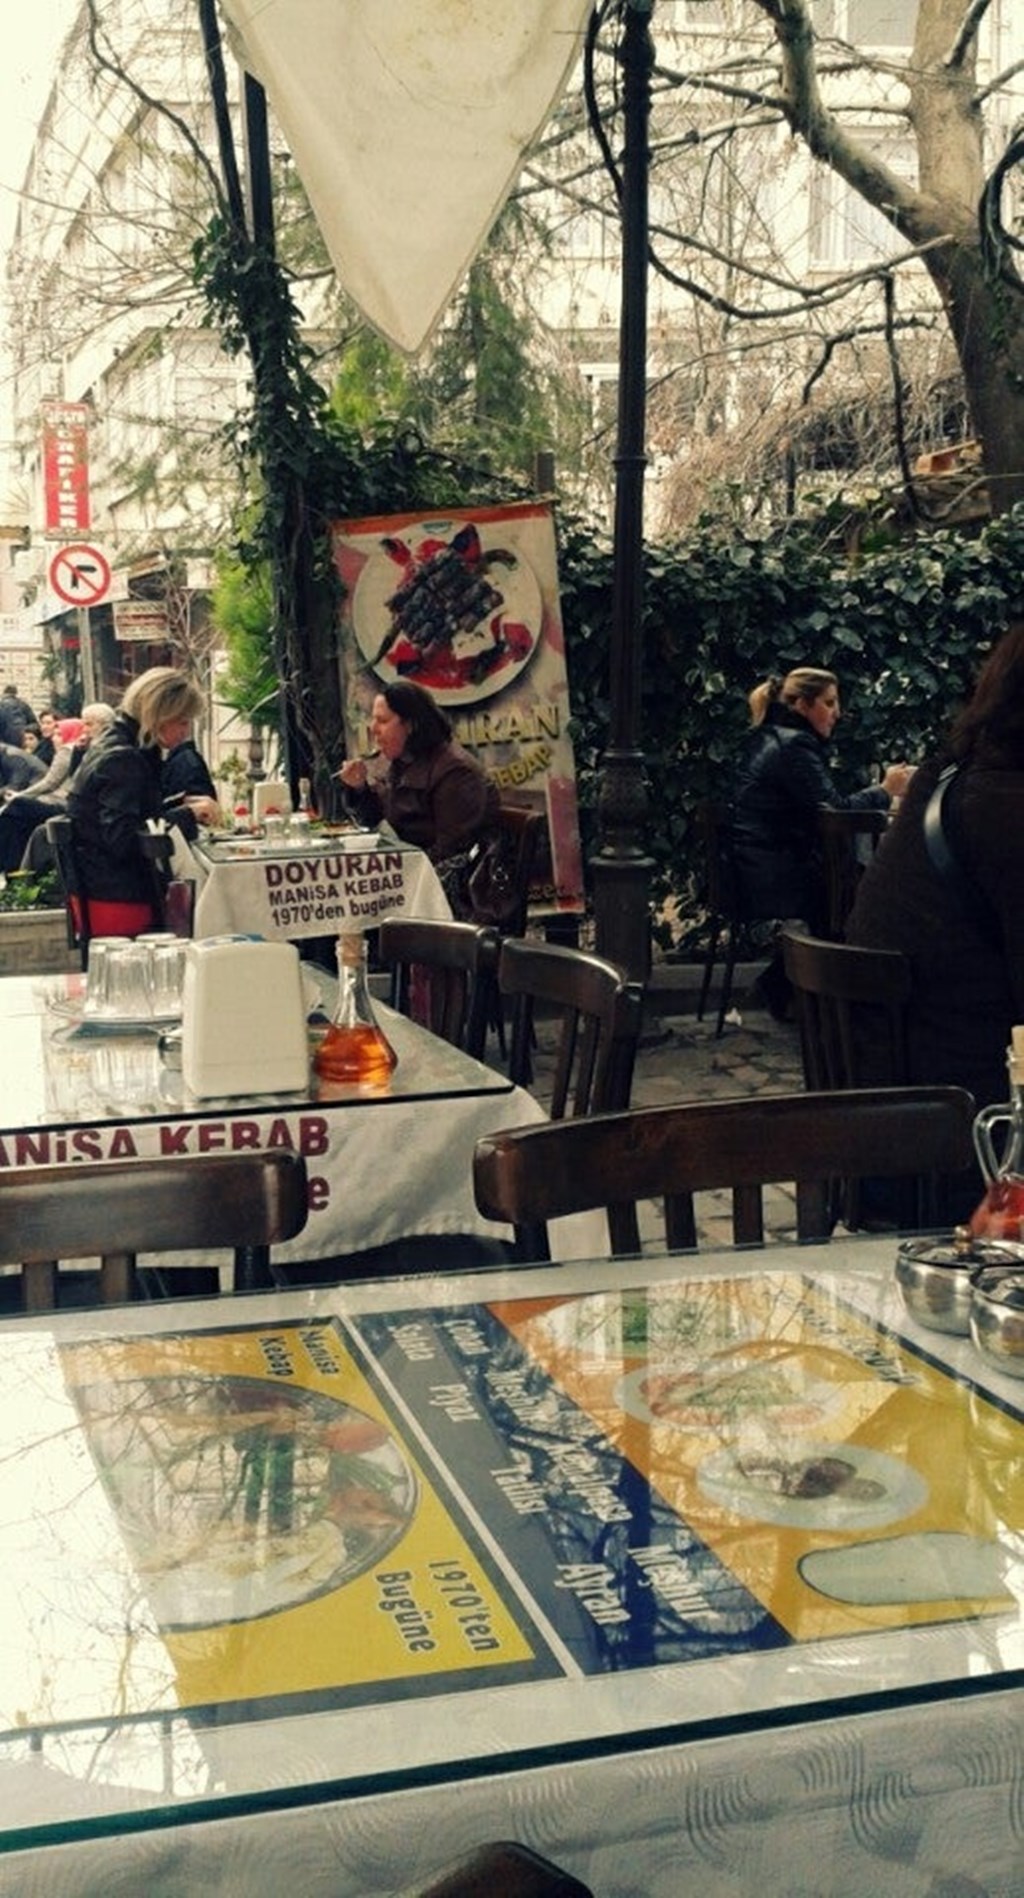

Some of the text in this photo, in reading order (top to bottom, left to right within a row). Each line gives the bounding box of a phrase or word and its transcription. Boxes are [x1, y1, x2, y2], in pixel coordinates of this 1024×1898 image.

[497, 744, 553, 789] EBAP
[264, 852, 402, 887] DOYURAN
[344, 873, 404, 896] KEBAB
[271, 892, 405, 927] 1970'den bugüne
[259, 1336, 294, 1376] Kebap
[429, 1384, 481, 1422] Piyaz
[376, 1570, 436, 1652] Bugüne
[429, 1560, 500, 1652] 1970'ten
[554, 1564, 632, 1626] Ayran
